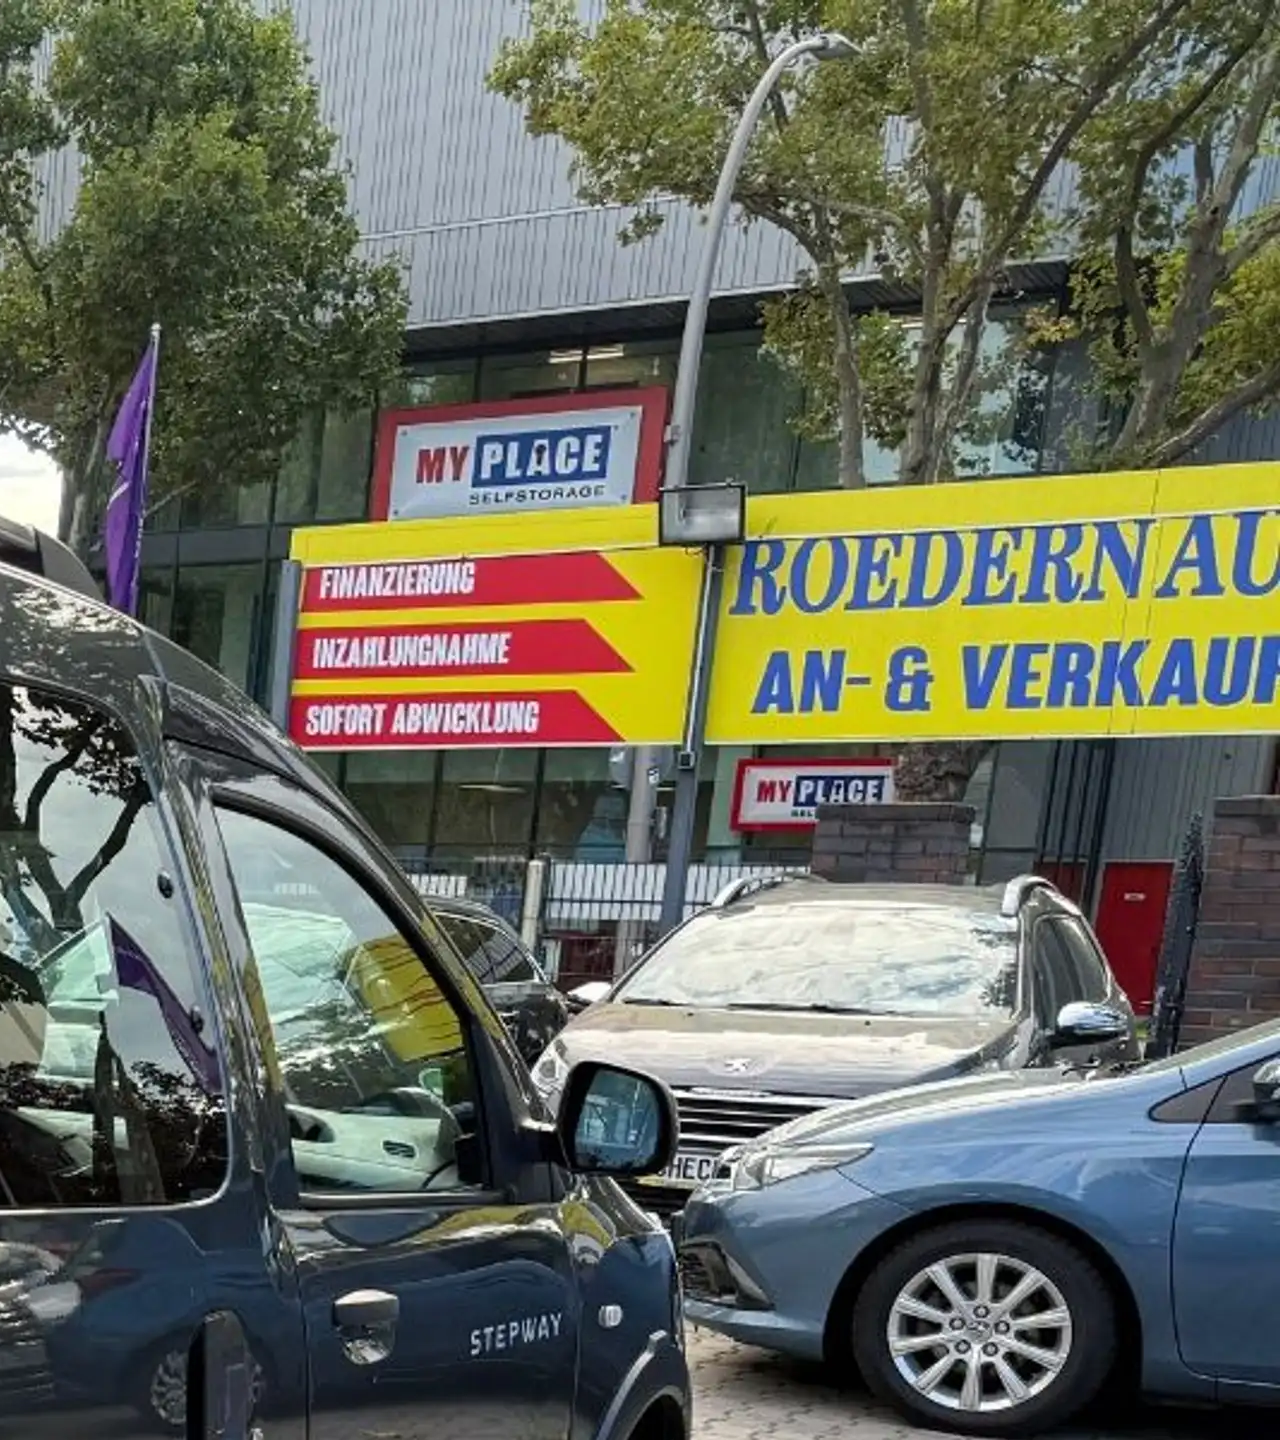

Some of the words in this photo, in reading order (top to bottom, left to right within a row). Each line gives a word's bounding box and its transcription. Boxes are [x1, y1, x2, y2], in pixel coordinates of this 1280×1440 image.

[416, 445, 471, 484] MY
[480, 434, 603, 480] PLACE
[469, 485, 605, 506] SELFSTORAGE
[319, 562, 476, 599] FINANZIERUNG
[312, 632, 513, 669] INZAHLUNGNAHME
[750, 650, 871, 714] AN-
[884, 646, 934, 712] &
[305, 703, 388, 736] SOFORT
[391, 700, 540, 735] ABWICKLUNG
[756, 779, 792, 803] MY
[798, 778, 880, 805] PLACE
[470, 1312, 562, 1356] STEPWAY
